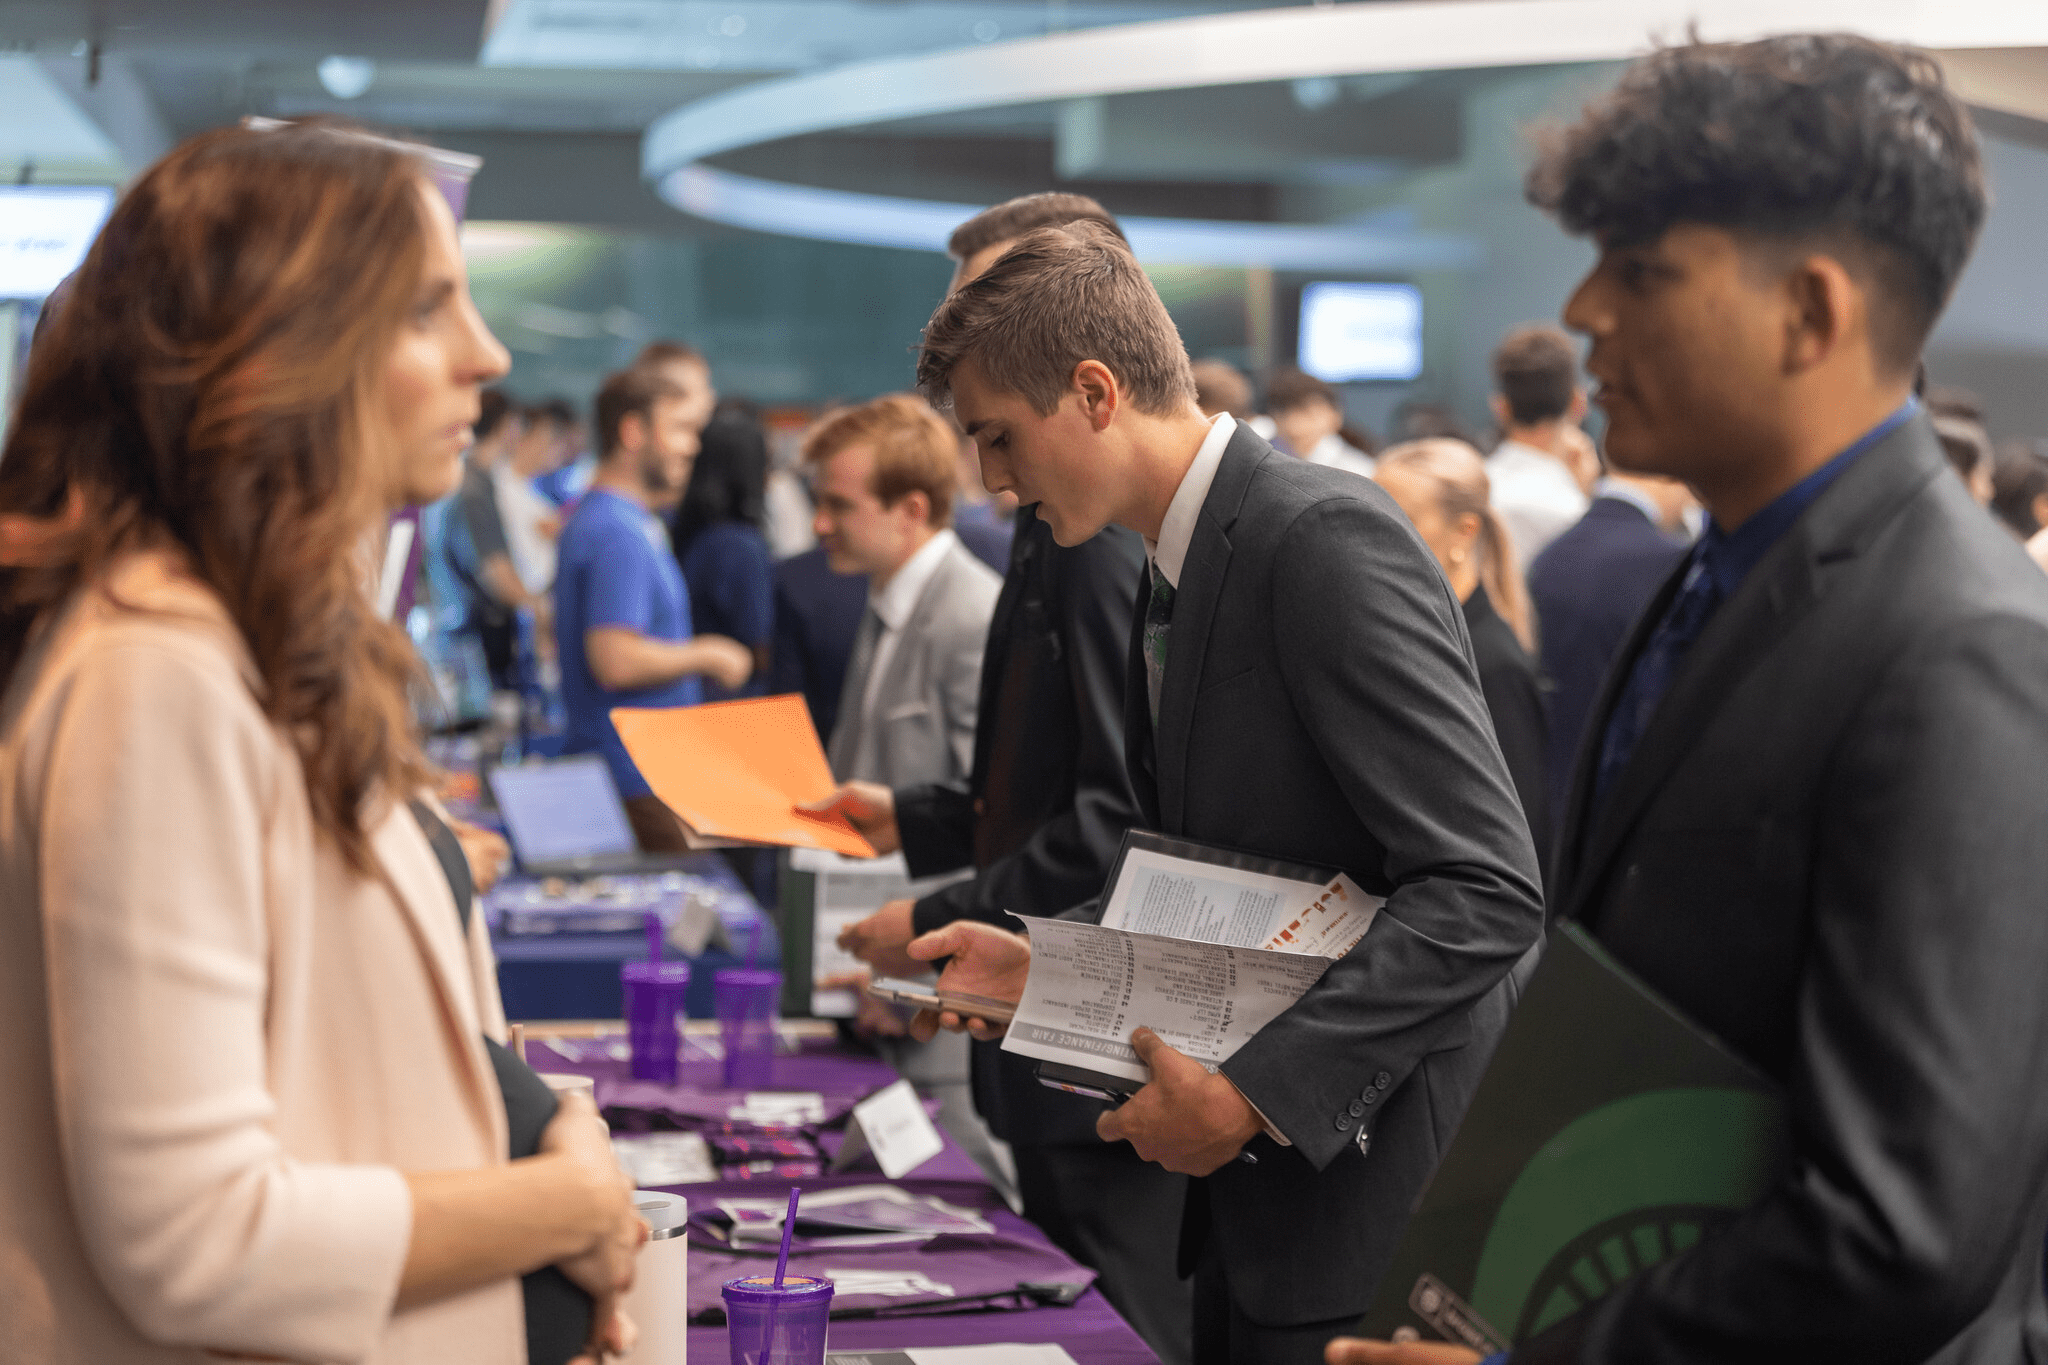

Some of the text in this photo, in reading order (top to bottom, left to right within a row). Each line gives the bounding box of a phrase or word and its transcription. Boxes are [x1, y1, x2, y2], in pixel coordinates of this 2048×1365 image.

[1038, 951, 1056, 959] AGENCY
[1082, 953, 1109, 962] FINANCIAL
[1073, 957, 1099, 966] CONTRACT
[1072, 963, 1108, 974] TECHNOLOGIES
[1101, 962, 1122, 970] DEFENSE
[1080, 972, 1100, 980] MAYHEW
[1178, 971, 1200, 979] REVENUE
[1202, 975, 1226, 983] INTERNAL
[1102, 976, 1120, 984] DOEREN
[1164, 975, 1225, 990] INTERNATIONAL DIVISION
[1154, 986, 1174, 994] SERVICE
[1183, 985, 1207, 993] BUSINESS
[1263, 987, 1287, 996] SERVICES
[1176, 990, 1198, 998] REVENUE
[1041, 998, 1068, 1007] INSURANCE
[1200, 995, 1223, 1003] INTERNAL
[1070, 1004, 1090, 1012] DEPOSIT
[1081, 999, 1115, 1010] CORPORATION
[1196, 1001, 1222, 1010] JPMORGAN
[1092, 1008, 1113, 1016] FEDERAL
[1031, 1028, 1055, 1042] FAIR
[1192, 1034, 1213, 1042] LANSING
